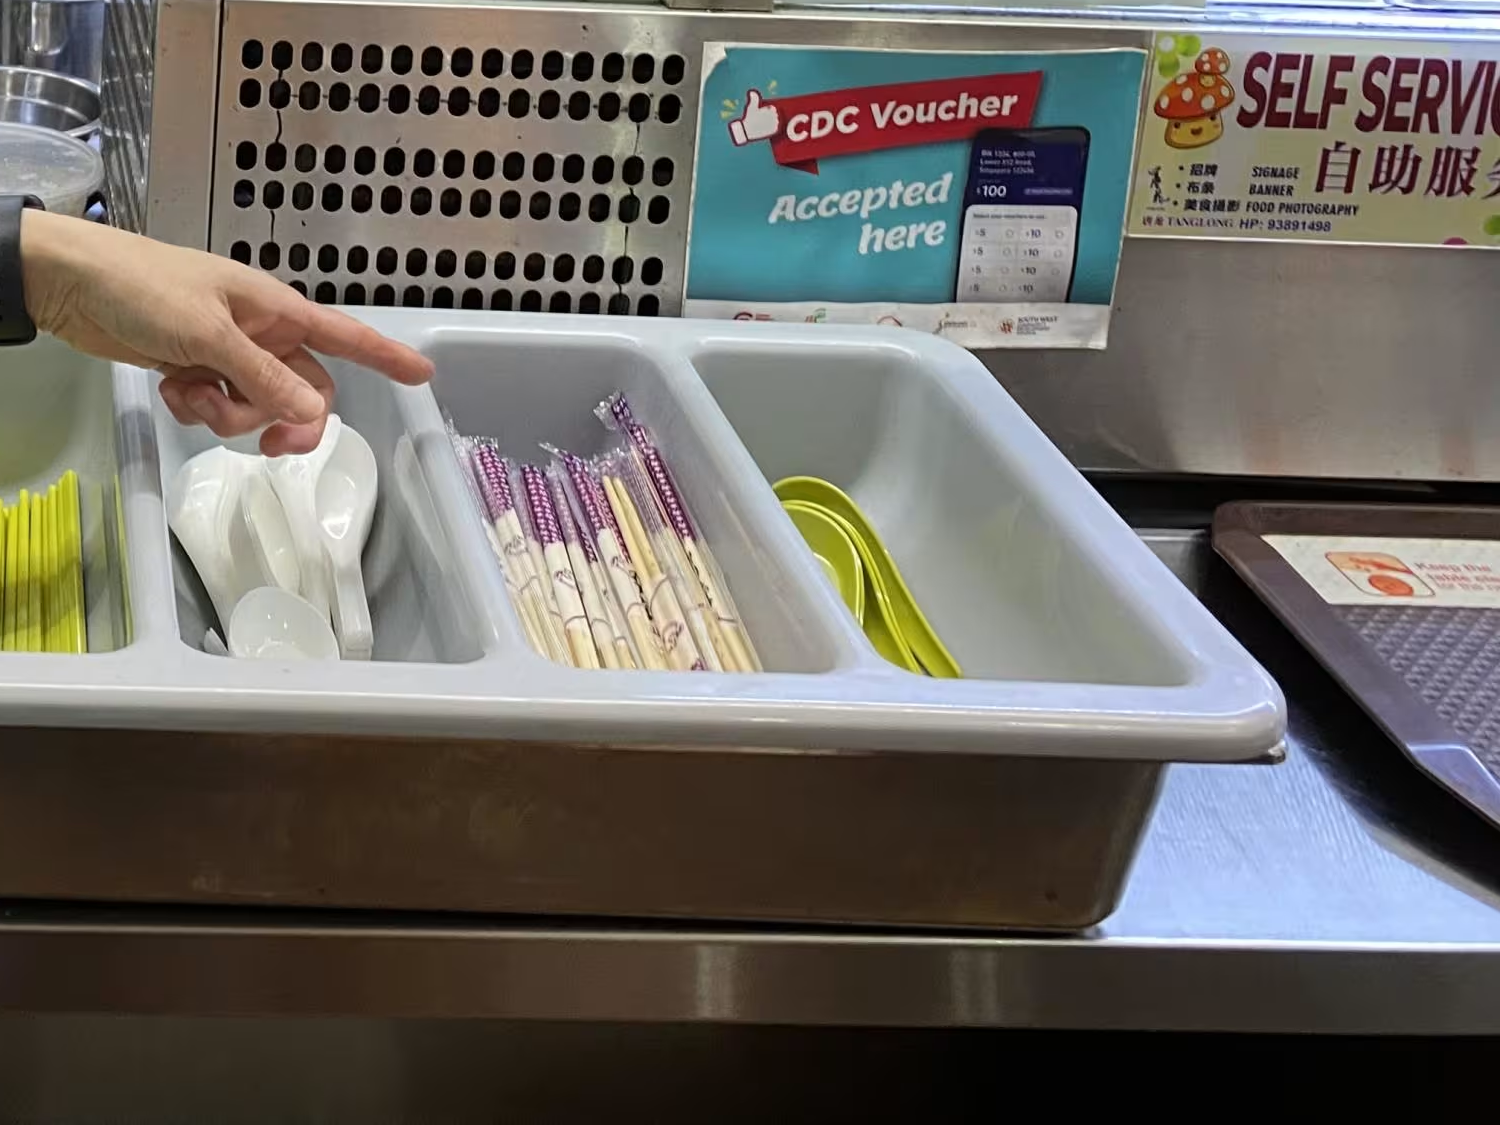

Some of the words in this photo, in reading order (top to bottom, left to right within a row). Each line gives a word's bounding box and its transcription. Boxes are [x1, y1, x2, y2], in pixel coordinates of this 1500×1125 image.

[1236, 50, 1356, 131] SELF
[785, 104, 861, 143] CDC
[869, 91, 1020, 130] Voucher
[1251, 165, 1301, 180] SIGNAGE
[767, 171, 954, 225] Accepted
[1248, 182, 1295, 197] BANNER
[1245, 201, 1275, 214] FOOD
[1278, 201, 1360, 217] PHOTOGRAPHY
[1167, 216, 1234, 229] TANGLONG
[858, 219, 947, 256] here
